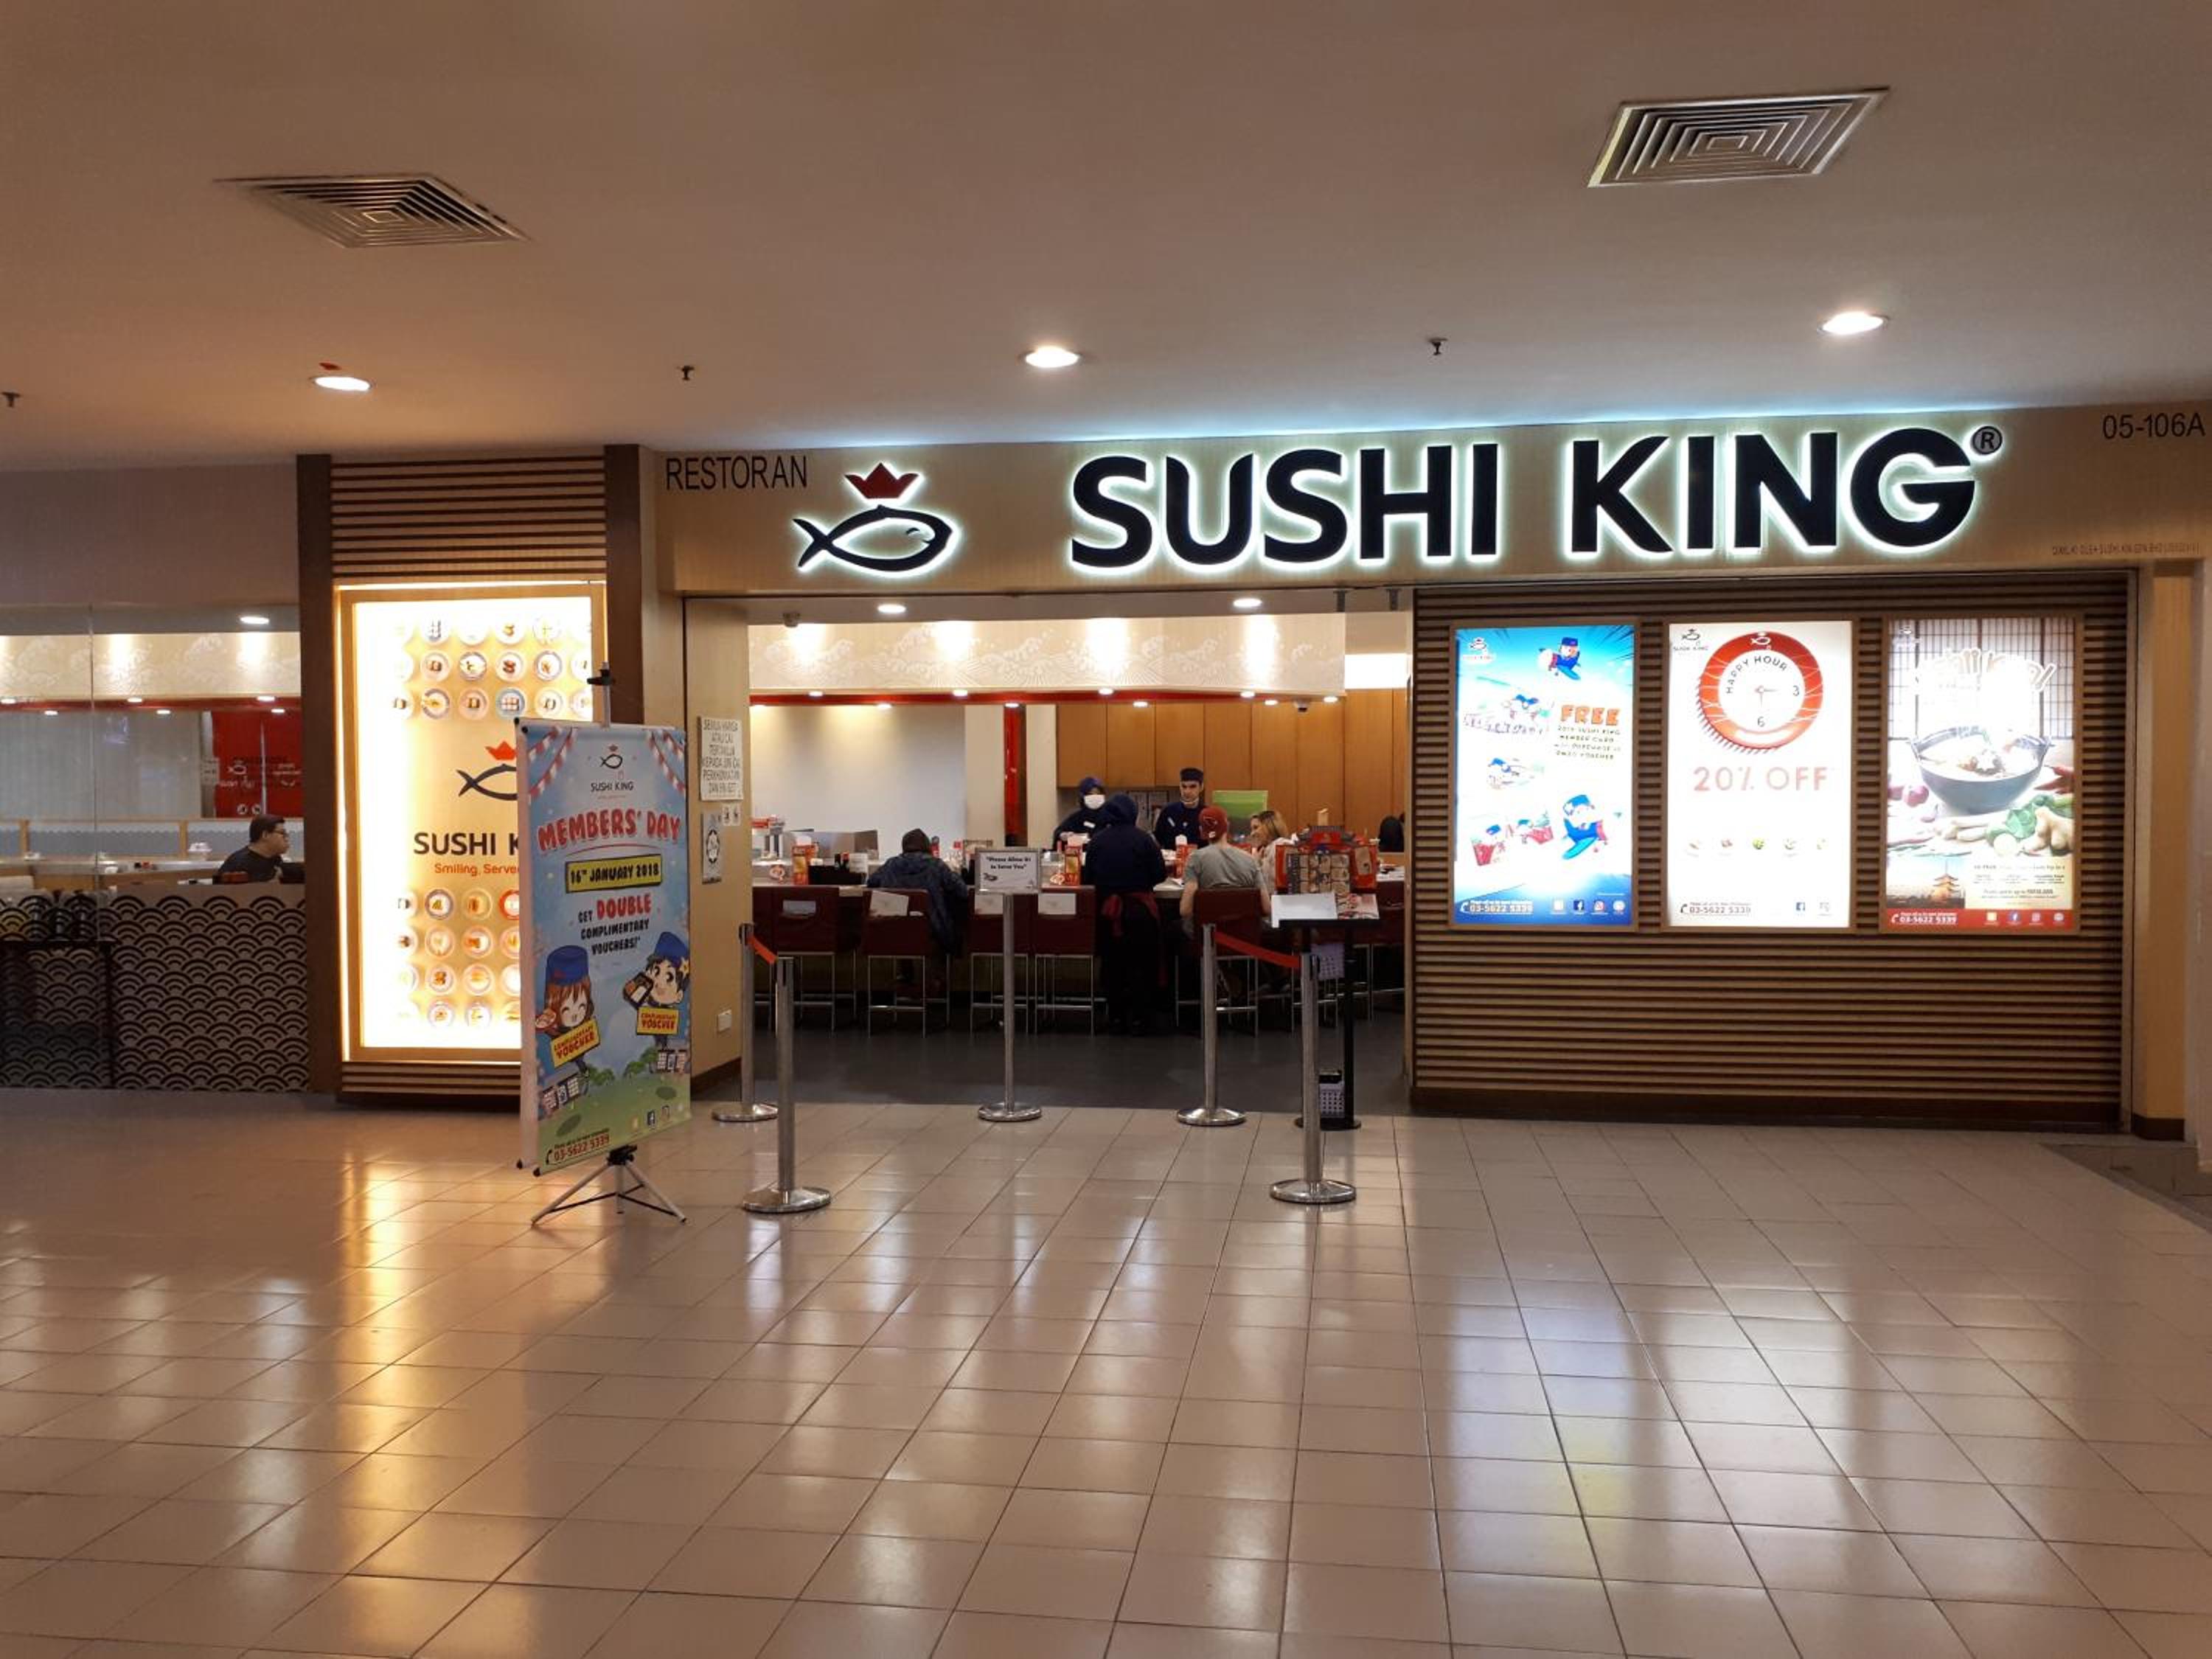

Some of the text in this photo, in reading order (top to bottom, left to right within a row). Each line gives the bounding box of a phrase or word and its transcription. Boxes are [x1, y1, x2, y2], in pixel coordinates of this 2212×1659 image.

[2102, 411, 2207, 439] 05-106A
[666, 455, 808, 491] RESTORAN
[1071, 442, 1499, 568] SUSHI
[1571, 427, 1976, 553] KING
[1725, 655, 1787, 695] HAPPY HOUR
[1792, 685, 1800, 697] 3
[1560, 704, 1621, 726] FREE
[1757, 716, 1765, 727] 6
[591, 781, 634, 792] SUSHI KING
[1694, 766, 1828, 791] 20% OFF
[538, 808, 642, 852] MEMBERS'
[646, 810, 680, 844] DAY
[413, 831, 496, 856] SUSHI
[589, 863, 634, 883] JANUARY
[636, 862, 659, 878] 2018
[577, 892, 652, 924] GET DOUBLE
[580, 918, 650, 941] COMPLIMENTARY
